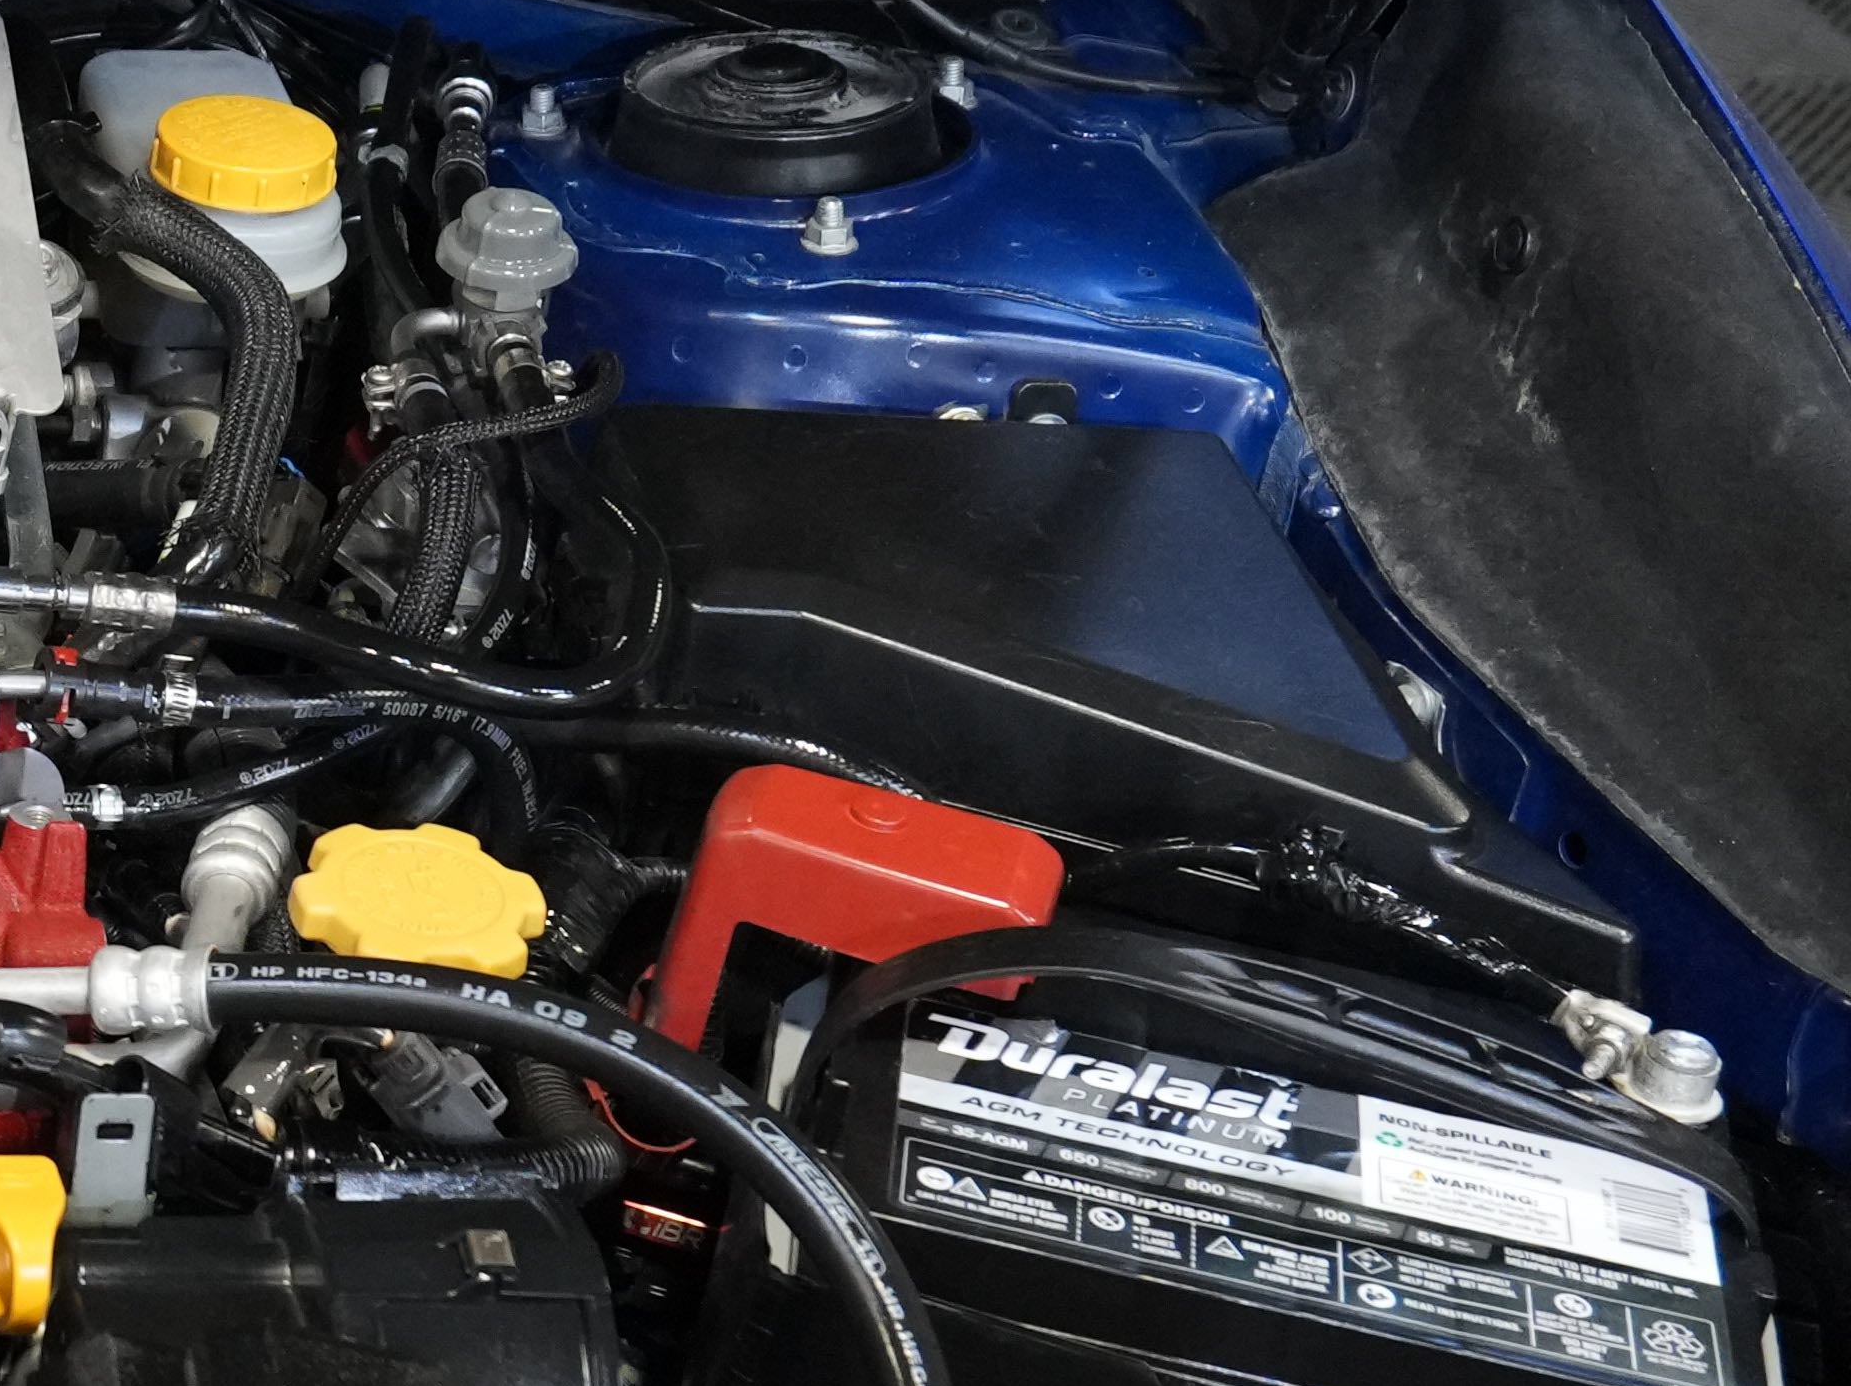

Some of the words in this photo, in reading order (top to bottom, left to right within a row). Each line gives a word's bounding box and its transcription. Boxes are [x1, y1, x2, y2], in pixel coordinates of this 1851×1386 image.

[382, 702, 427, 718] 50087
[251, 965, 285, 978] HP
[296, 966, 427, 988] HFC-134a
[459, 982, 512, 1009] HA
[532, 999, 588, 1029] 09
[609, 1027, 638, 1052] 2
[928, 1012, 1300, 1130] Duralast
[1062, 1087, 1288, 1150] PLATINUM
[950, 1123, 1029, 1152] 35-AGM
[960, 1094, 1041, 1123] AGM
[1056, 1116, 1297, 1178] TECHNOLOGY
[1378, 1113, 1553, 1160] NON-SPILLABLE
[1059, 1147, 1100, 1167] 650
[1042, 1173, 1231, 1227] DANGER/POISON
[1183, 1177, 1227, 1198] 800
[1430, 1174, 1540, 1208] WARNING:
[1314, 1205, 1352, 1225] 100
[1416, 1229, 1446, 1248] 55
